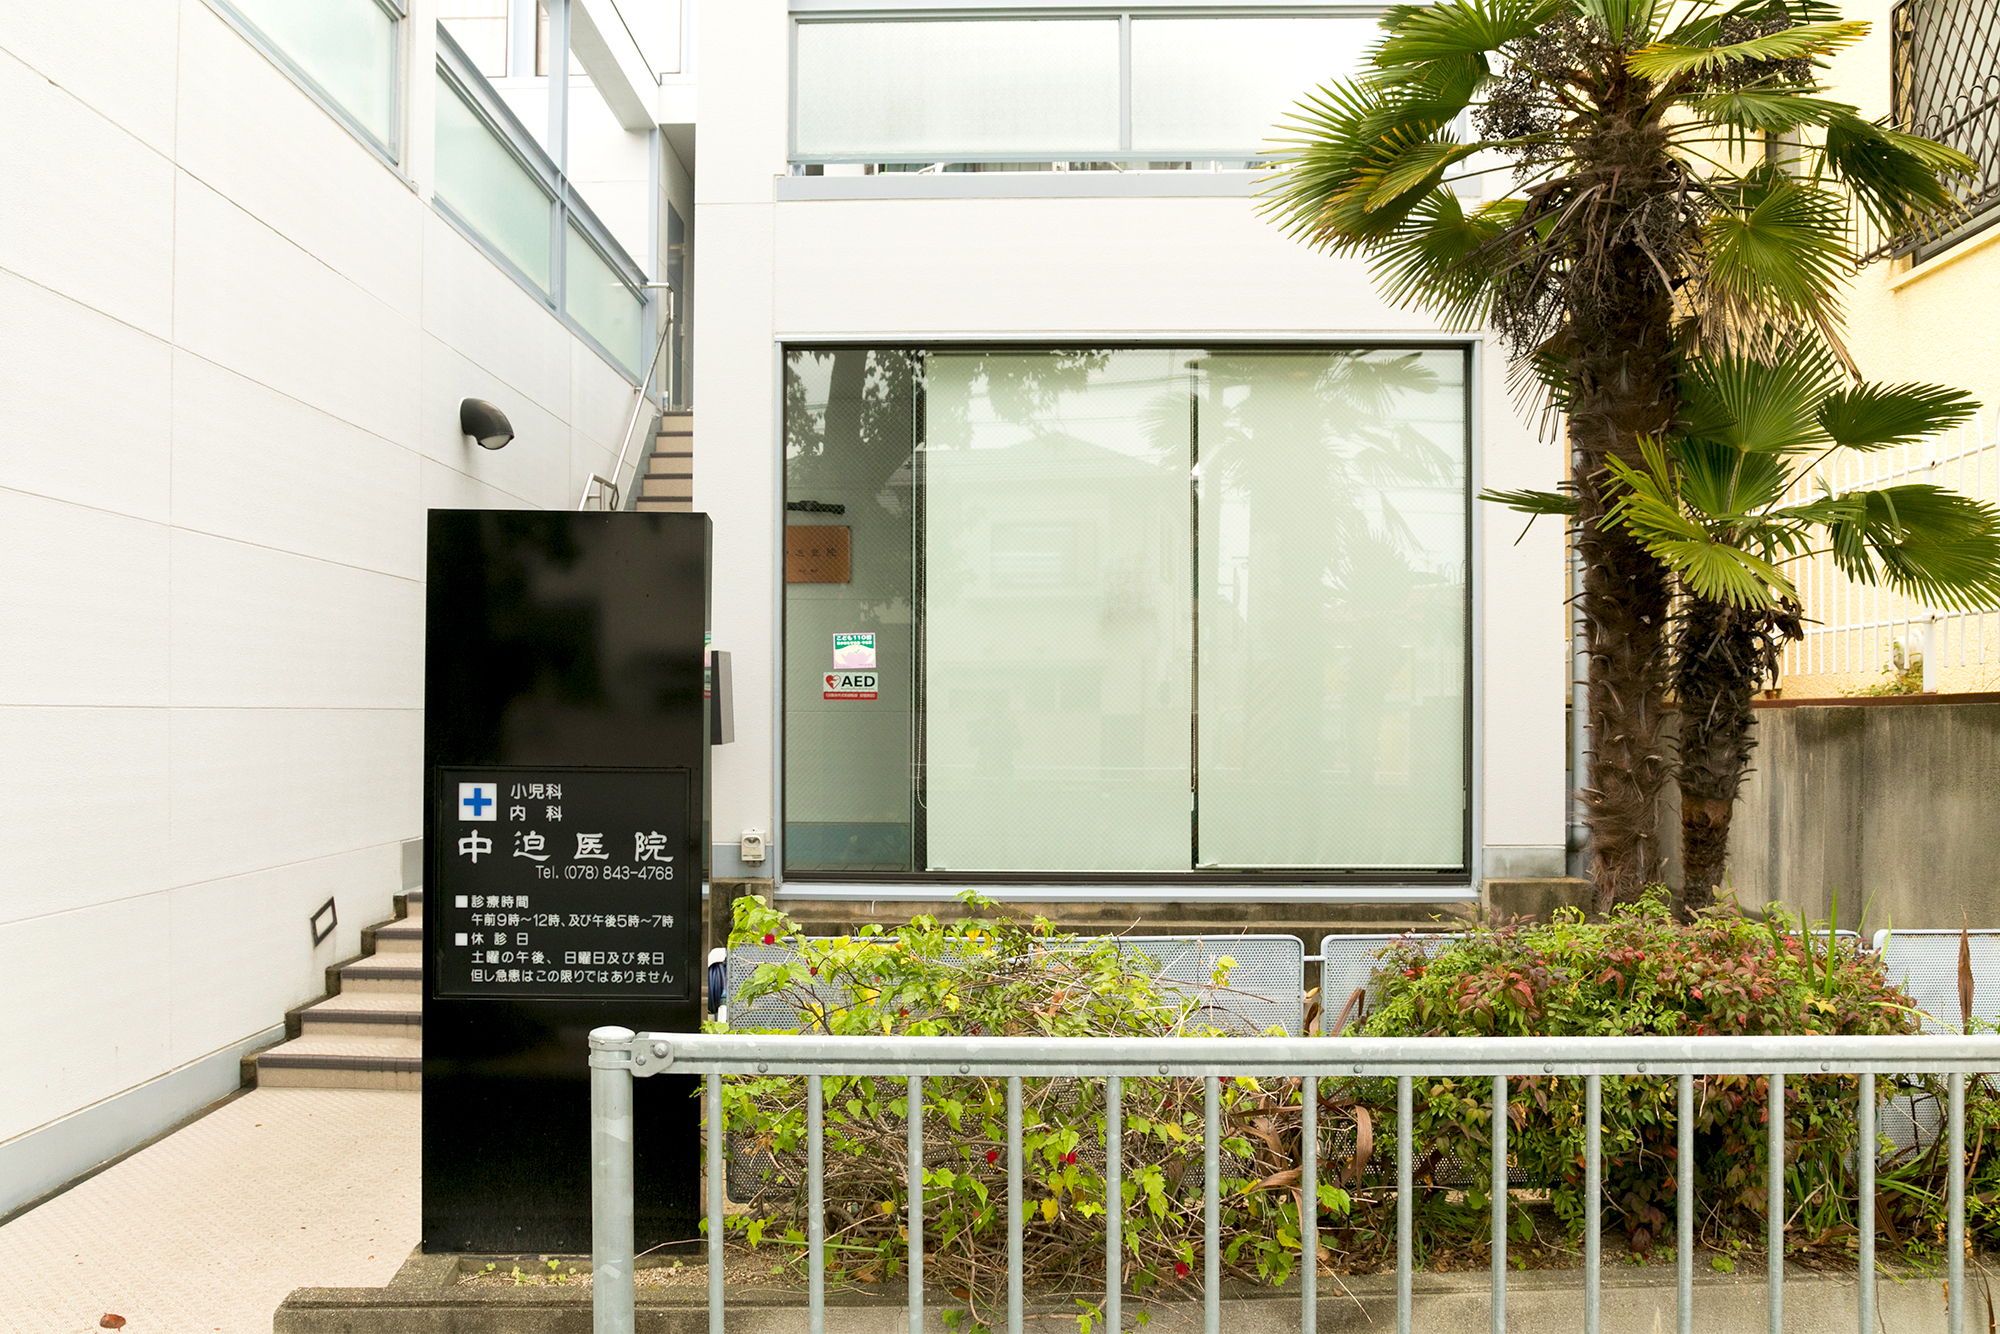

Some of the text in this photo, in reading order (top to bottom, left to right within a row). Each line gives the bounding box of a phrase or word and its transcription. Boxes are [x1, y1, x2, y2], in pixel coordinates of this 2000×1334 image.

[841, 675, 876, 687] AED
[509, 783, 563, 800] 小児科
[509, 805, 563, 822] 内科
[457, 829, 674, 864] 中迫医院
[535, 865, 674, 881] Tel. (078) 843-4768
[471, 895, 529, 909] 診療時間
[470, 968, 674, 984] 但し急患はこの限りではありません
